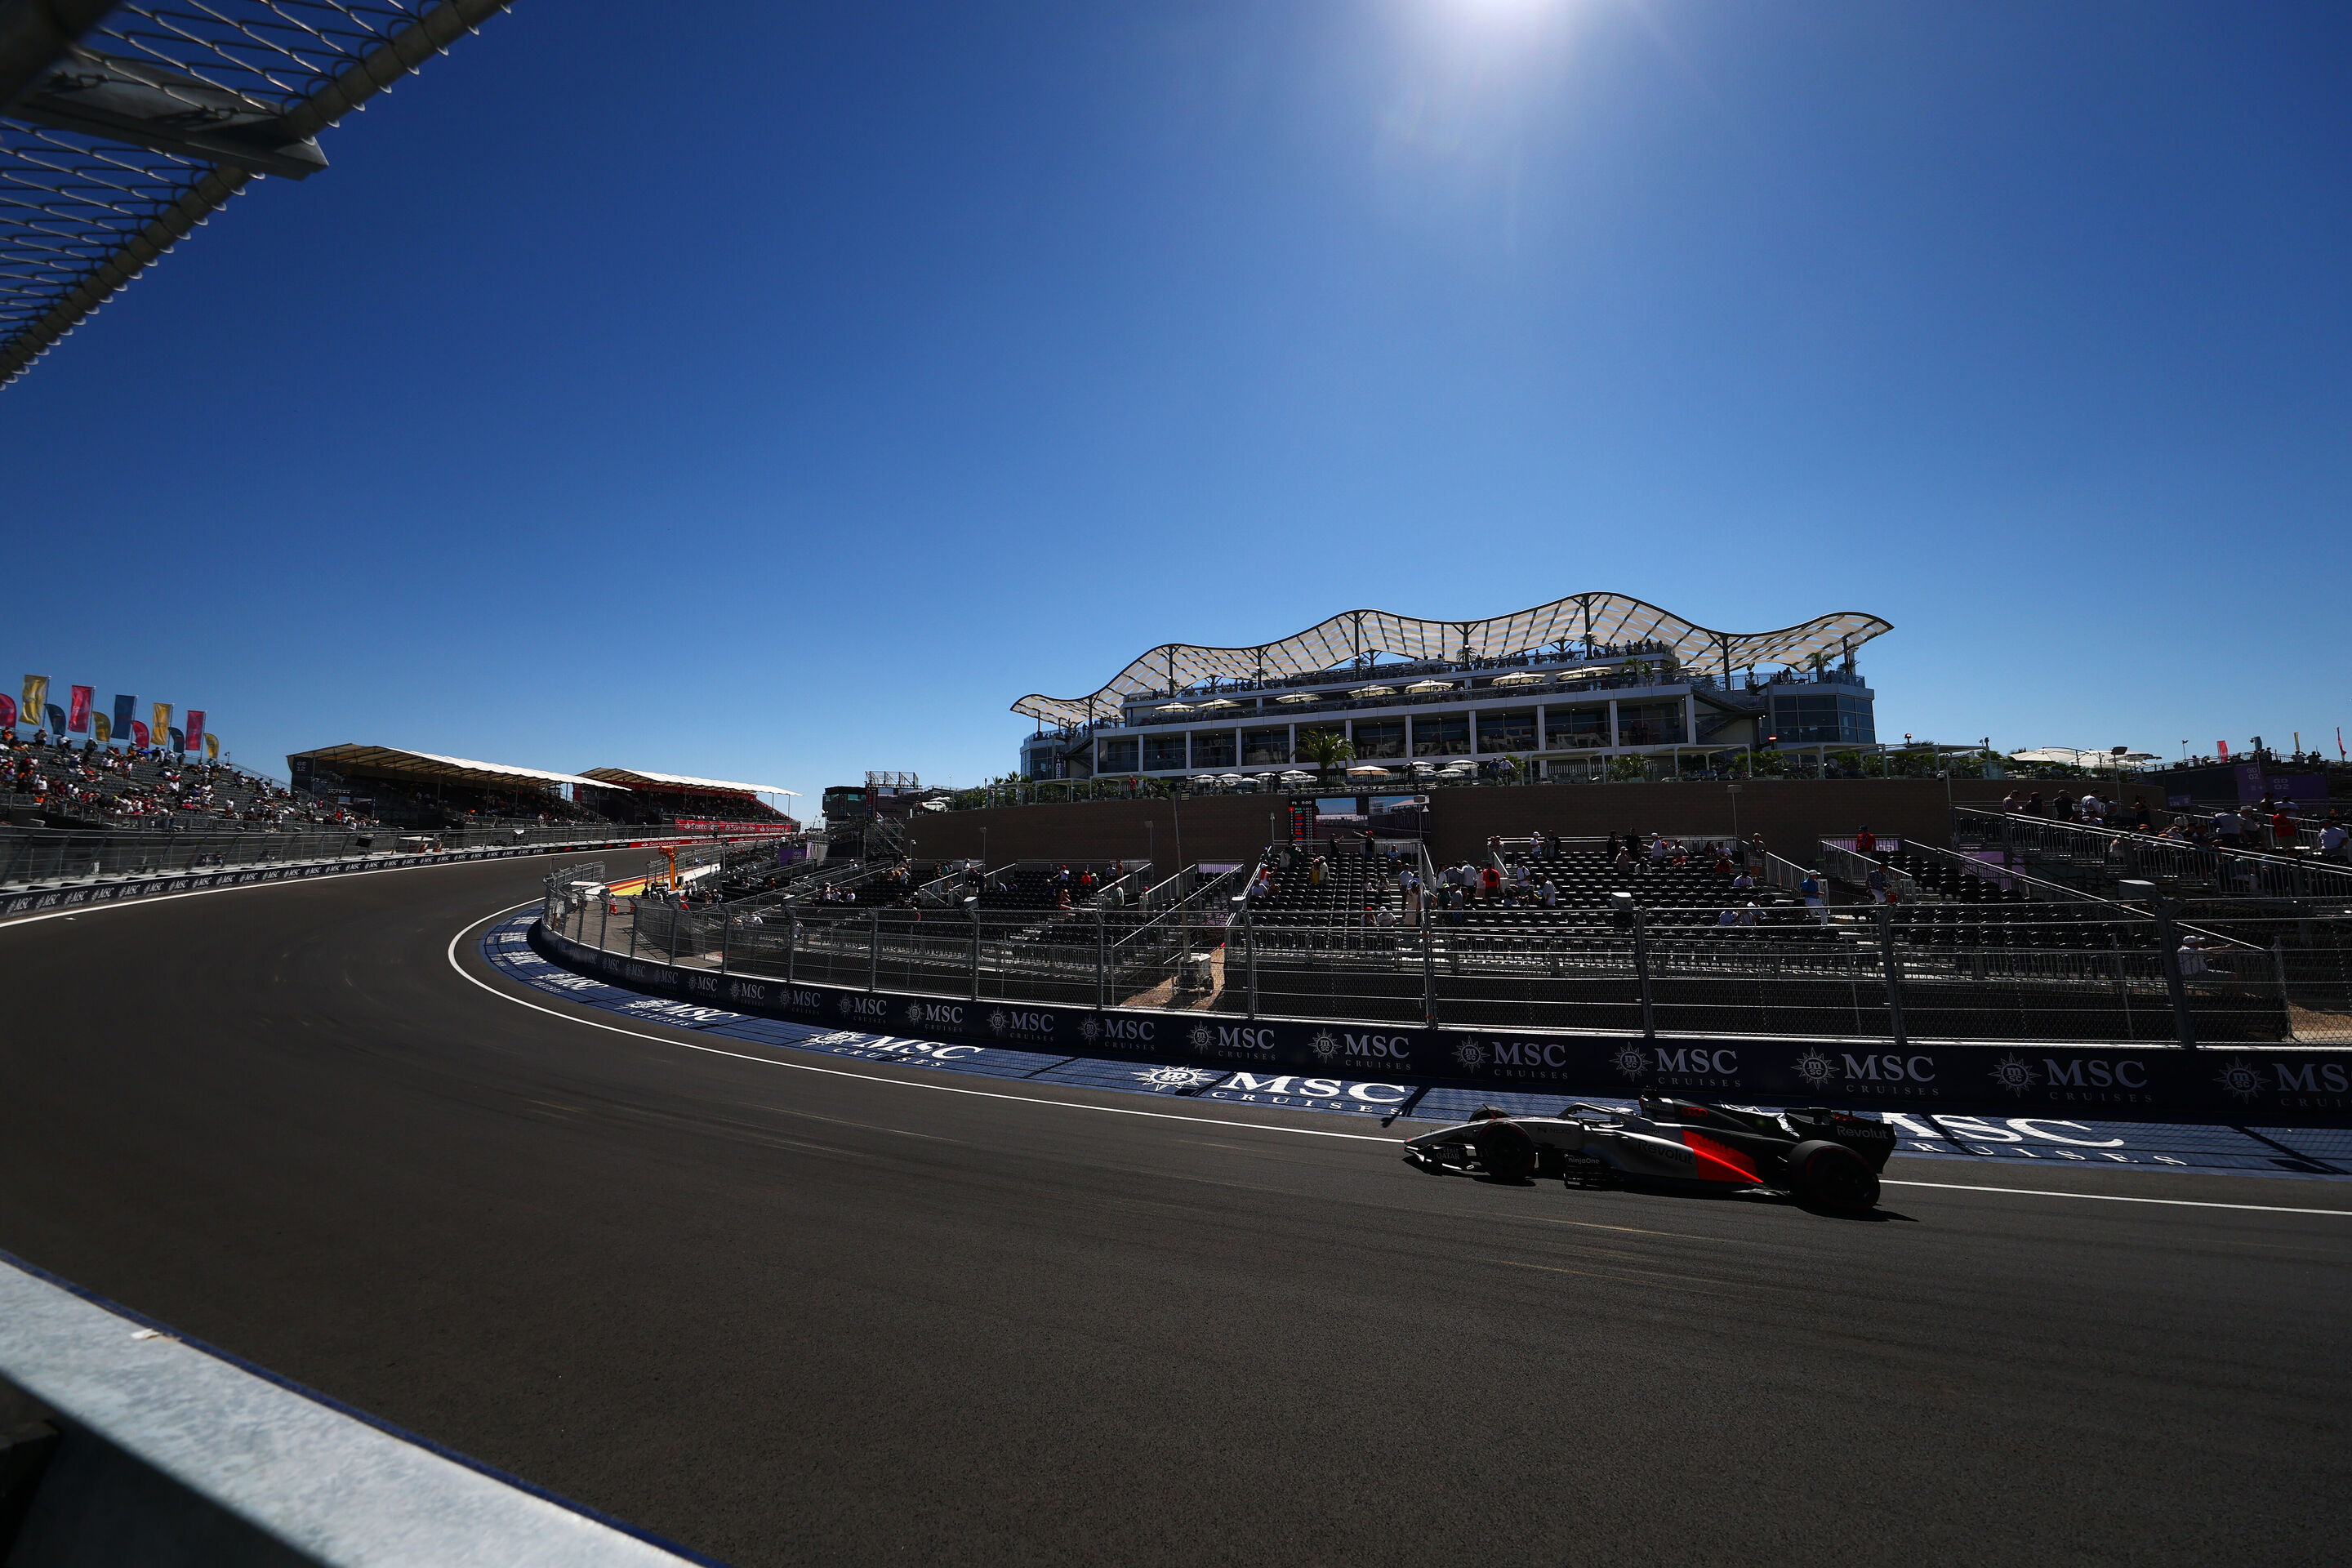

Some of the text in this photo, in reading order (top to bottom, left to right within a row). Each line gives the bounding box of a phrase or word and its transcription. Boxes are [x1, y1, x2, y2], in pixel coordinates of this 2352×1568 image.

[661, 969, 678, 984] MSC
[697, 976, 717, 991] MSC
[742, 983, 764, 999] MSC
[792, 990, 821, 1008] MSC
[652, 1003, 742, 1022] MSC
[854, 996, 887, 1016] MSC
[925, 1004, 963, 1024] MSC
[1011, 1011, 1054, 1032] MSC
[1104, 1018, 1155, 1041] MSC
[1011, 1032, 1054, 1042] CRUISES
[1105, 1041, 1155, 1051] CRUISES
[1218, 1026, 1275, 1050] MSC
[1344, 1033, 1410, 1058] MSC
[853, 1035, 985, 1060] MSC
[1218, 1050, 1276, 1061] CRUISES
[1492, 1041, 1566, 1067] MSC
[1345, 1059, 1411, 1071] CRUISES
[1655, 1048, 1738, 1074] MSC
[1841, 1054, 1936, 1082] MSC
[1494, 1068, 1568, 1079] CRUISES
[1657, 1077, 1741, 1088] CRUISES
[2042, 1059, 2149, 1089] MSC
[2271, 1062, 2352, 1093] MS
[1218, 1071, 1405, 1102] MSC
[1846, 1084, 1940, 1096] CRUISES
[1211, 1091, 1403, 1116] CRUISES
[2050, 1091, 2152, 1103] CRUISES
[2280, 1098, 2352, 1108] CRUI
[1837, 1125, 1889, 1140] Revolut
[1638, 1139, 1693, 1165] Revolut
[1908, 1141, 2188, 1166] RUISES
